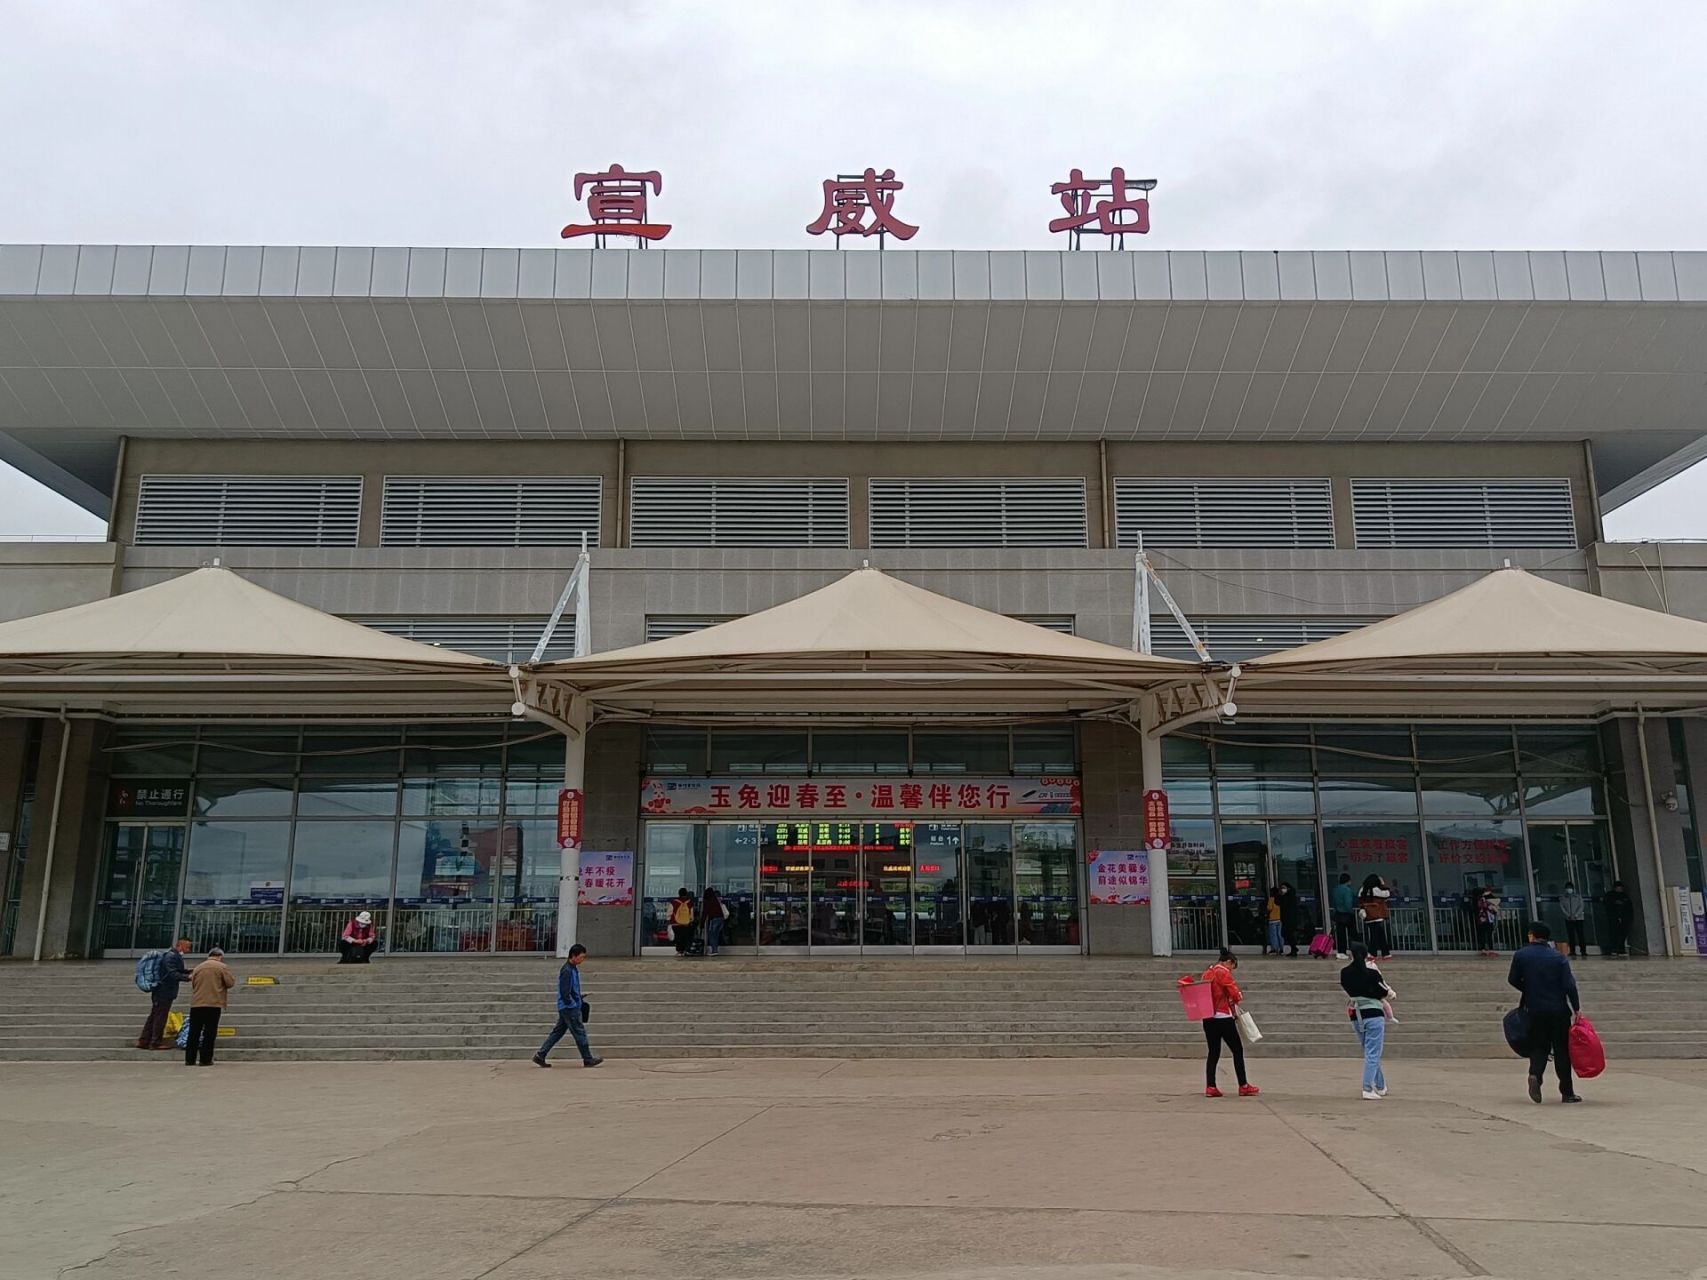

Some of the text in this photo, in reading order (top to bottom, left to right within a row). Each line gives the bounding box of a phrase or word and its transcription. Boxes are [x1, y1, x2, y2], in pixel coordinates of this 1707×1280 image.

[561, 163, 1157, 241] 宣威站
[136, 788, 185, 800] 禁止通行
[709, 784, 1011, 809] 玉兔迎春至·温馨伴您行
[585, 878, 625, 888] 春暖花开
